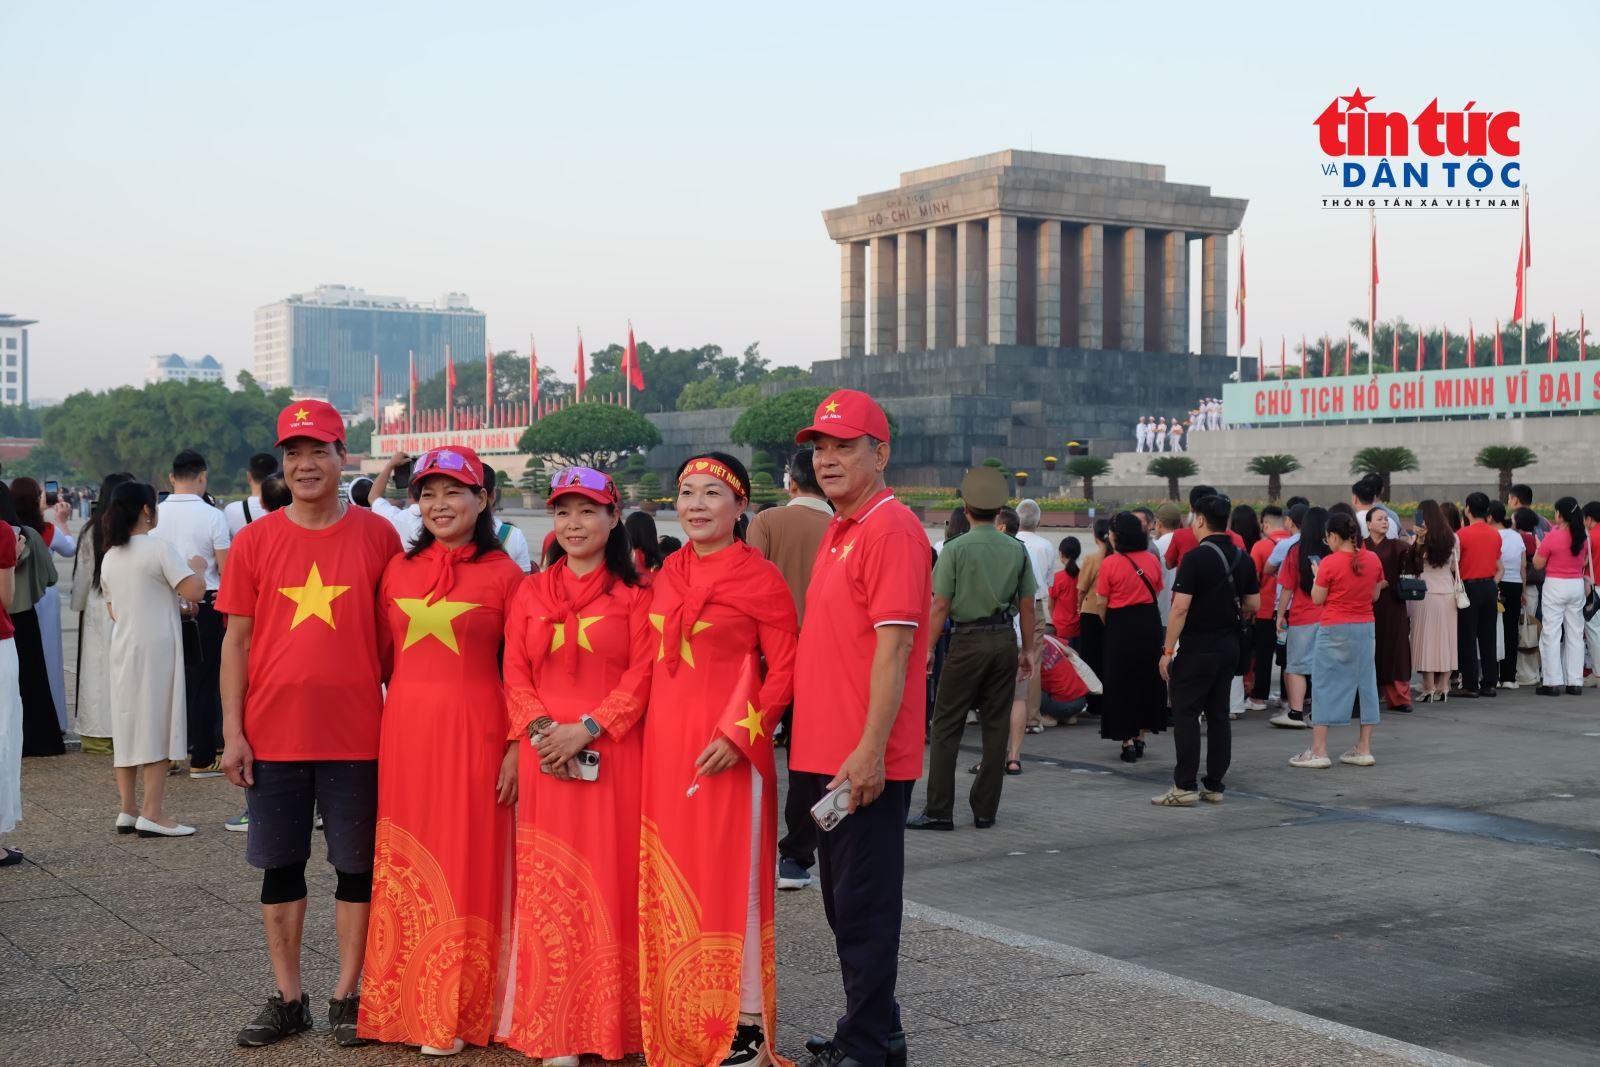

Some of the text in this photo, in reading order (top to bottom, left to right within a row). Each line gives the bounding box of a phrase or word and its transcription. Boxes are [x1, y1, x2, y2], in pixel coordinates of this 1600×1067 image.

[1255, 381, 1292, 416] CHỦ
[1300, 386, 1344, 419] TỊCH
[1353, 374, 1380, 412] HỒ
[1389, 375, 1424, 410] CHÍ
[1434, 376, 1495, 409] MINH
[1506, 369, 1529, 405] VĨ
[1539, 371, 1581, 408] ĐẠI
[710, 463, 727, 478] VIỆT
[725, 472, 742, 490] NAM
